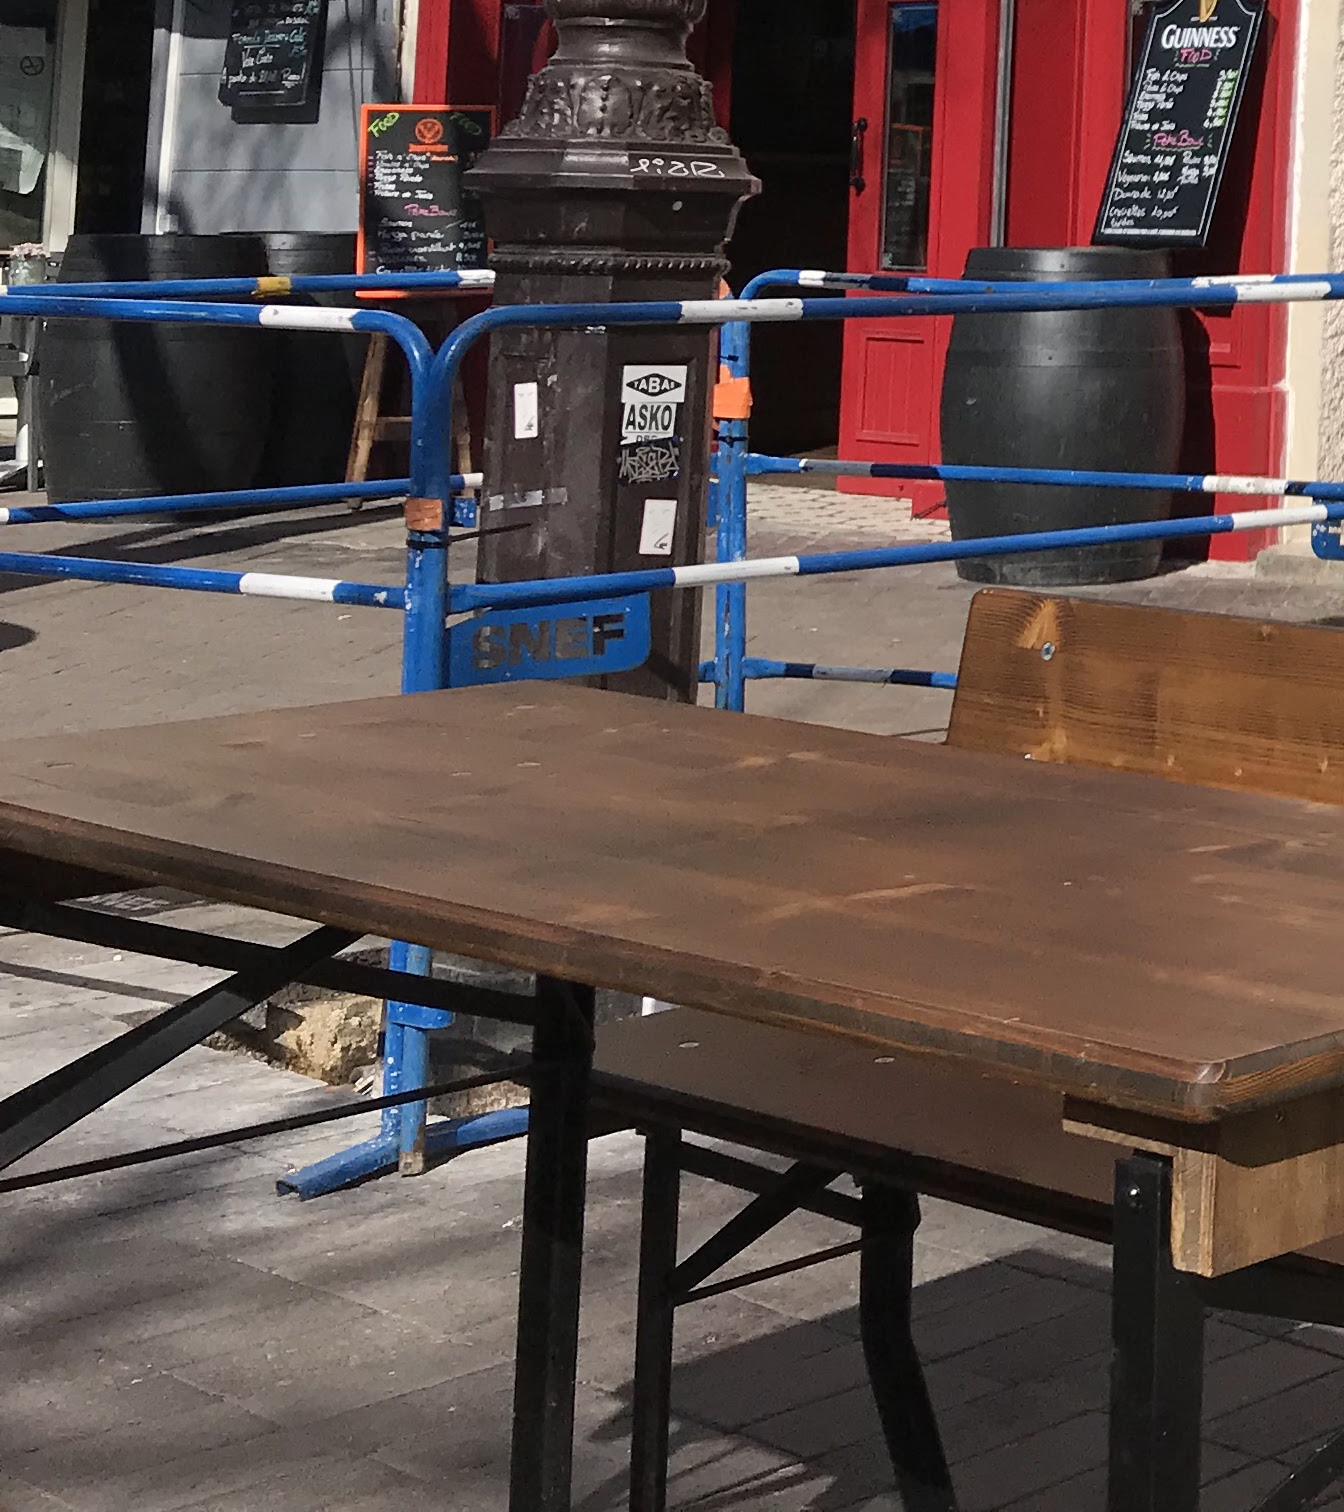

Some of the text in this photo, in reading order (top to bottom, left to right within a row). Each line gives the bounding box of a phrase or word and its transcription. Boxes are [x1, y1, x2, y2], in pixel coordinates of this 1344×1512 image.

[1160, 23, 1239, 50] GUINNESS
[625, 404, 672, 431] ASKO
[471, 613, 626, 669] SNEF
